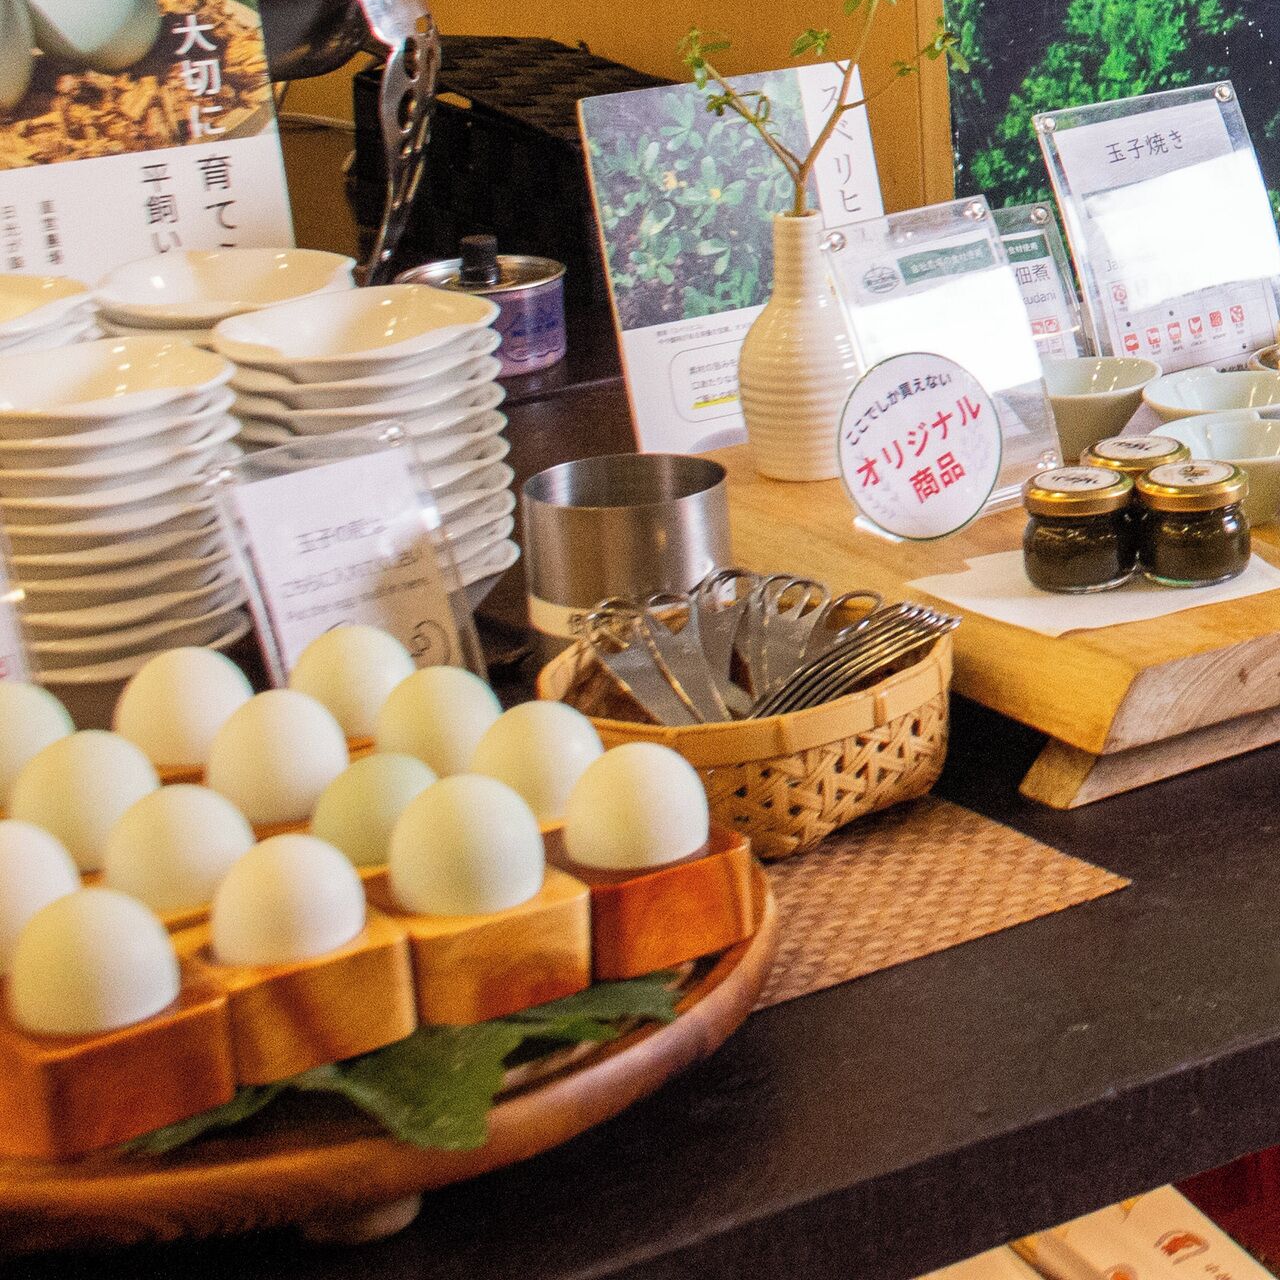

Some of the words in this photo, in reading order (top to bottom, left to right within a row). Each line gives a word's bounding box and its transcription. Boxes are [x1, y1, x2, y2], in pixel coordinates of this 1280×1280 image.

[172, 14, 237, 249] 大切に育て
[1105, 129, 1184, 164] 玉子焼き
[142, 163, 182, 254] 平飼い
[1015, 263, 1051, 287] 佃煮
[845, 373, 953, 446] ここでしか買えない
[855, 394, 982, 488] オリジナル
[908, 451, 967, 505] 商品
